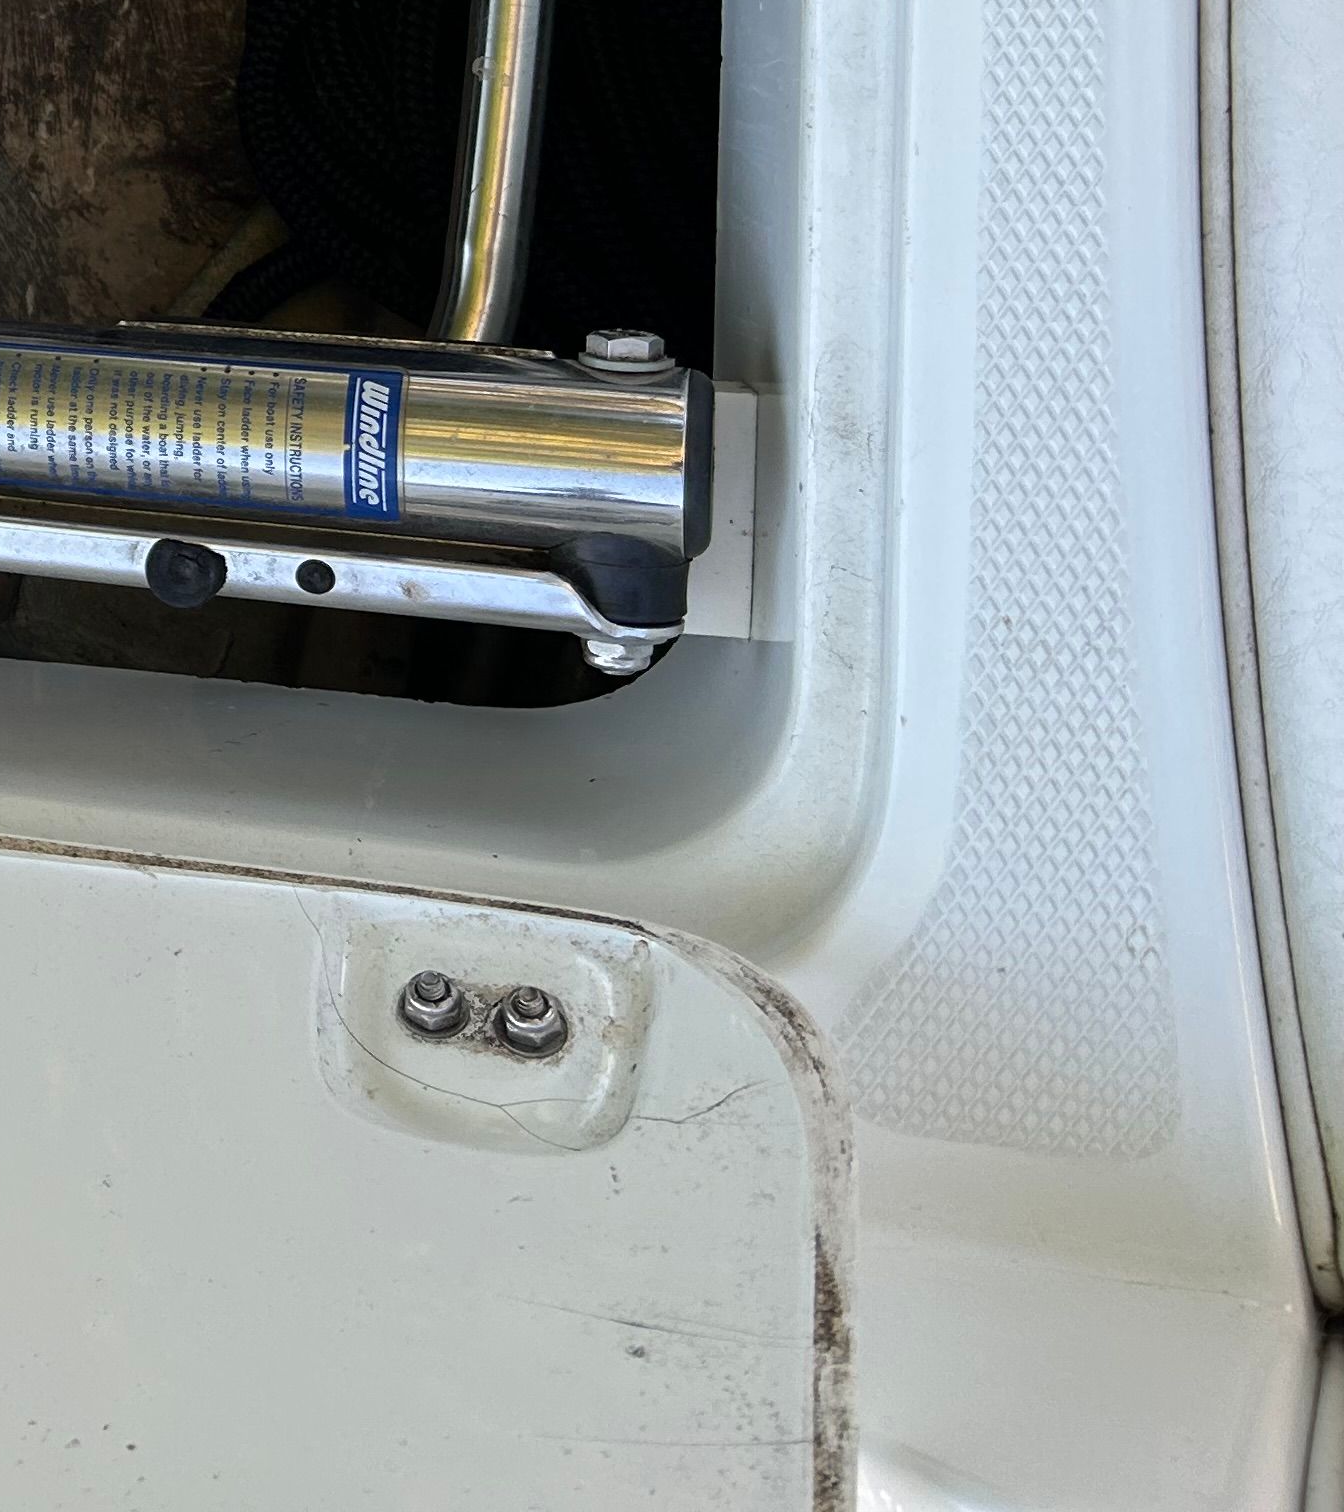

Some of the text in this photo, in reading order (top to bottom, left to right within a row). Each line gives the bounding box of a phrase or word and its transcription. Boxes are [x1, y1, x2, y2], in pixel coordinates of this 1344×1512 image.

[71, 367, 82, 399] ladder
[87, 368, 100, 391] Only
[111, 379, 120, 399] was
[128, 370, 138, 398] other
[217, 377, 231, 400] Stay
[244, 380, 255, 404] Face
[7, 362, 22, 453] Check ladder and
[28, 364, 43, 451] motor is running
[46, 397, 55, 417] use
[69, 401, 79, 412] at
[85, 394, 95, 415] one
[144, 391, 154, 402] of
[157, 374, 172, 420] boarding
[109, 402, 119, 421] not
[124, 400, 135, 446] purpose
[143, 405, 153, 422] the
[218, 403, 226, 417] on
[46, 420, 57, 453] ladder
[68, 415, 78, 432] the
[83, 417, 95, 454] person
[192, 376, 207, 482] Never use ladder for
[241, 407, 253, 443] ladder
[262, 382, 280, 476] For boat use only
[68, 434, 78, 462] same
[107, 423, 120, 471] designed
[140, 425, 151, 458] water,
[159, 433, 169, 457] boat
[216, 420, 225, 455] center
[289, 378, 307, 501] SAFETY INSTRUCTIONS
[358, 380, 389, 505] Windline
[86, 457, 94, 469] on
[125, 448, 136, 463] for
[142, 460, 151, 471] or
[159, 459, 170, 478] that
[216, 458, 226, 469] of
[240, 445, 251, 474] when
